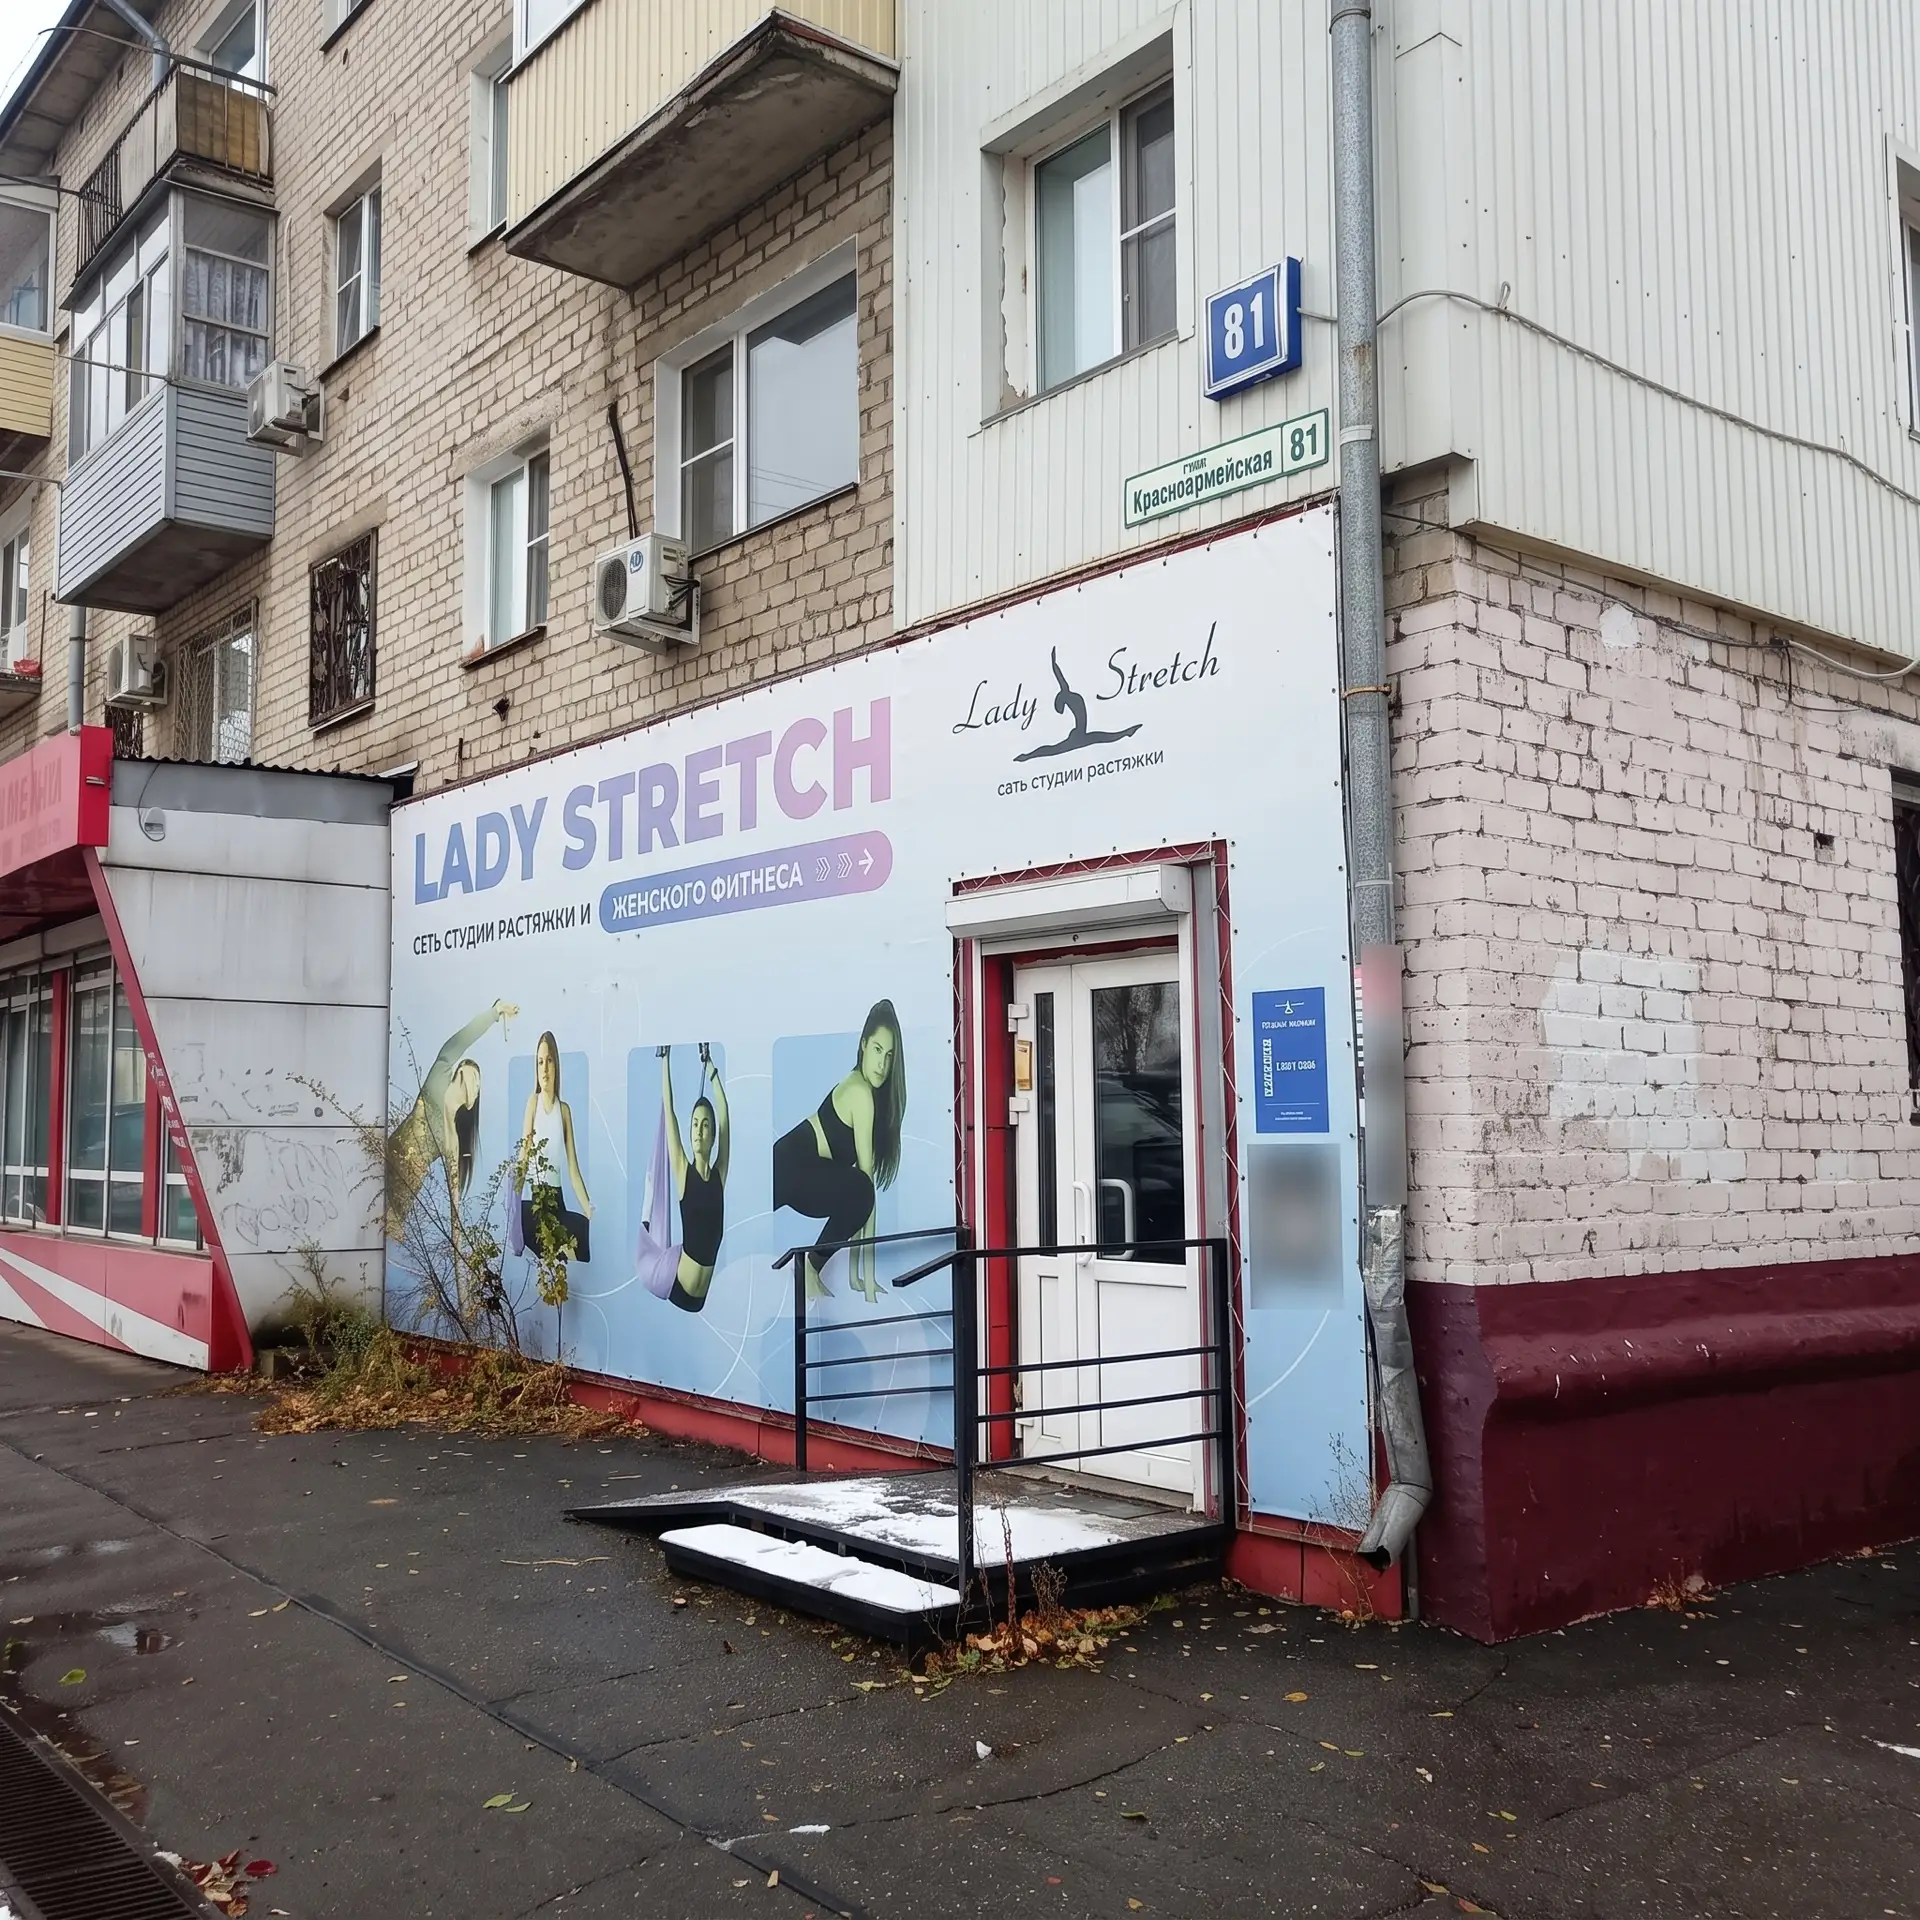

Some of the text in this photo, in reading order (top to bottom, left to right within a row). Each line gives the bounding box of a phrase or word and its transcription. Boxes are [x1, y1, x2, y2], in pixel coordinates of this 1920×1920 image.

[1223, 291, 1265, 360] 81
[1290, 423, 1318, 462] 81
[1132, 449, 1273, 515] Красноармейская
[952, 620, 1221, 734] Lady Stretch
[414, 695, 892, 906] LADY STRETCH
[1030, 766, 1084, 791] студии
[1086, 750, 1165, 783] растяжки
[413, 861, 804, 956] СЕТЬ СТУДИИ РАСТЯЖКИ И ЖЕНСКОГО ФИТНЕСА
